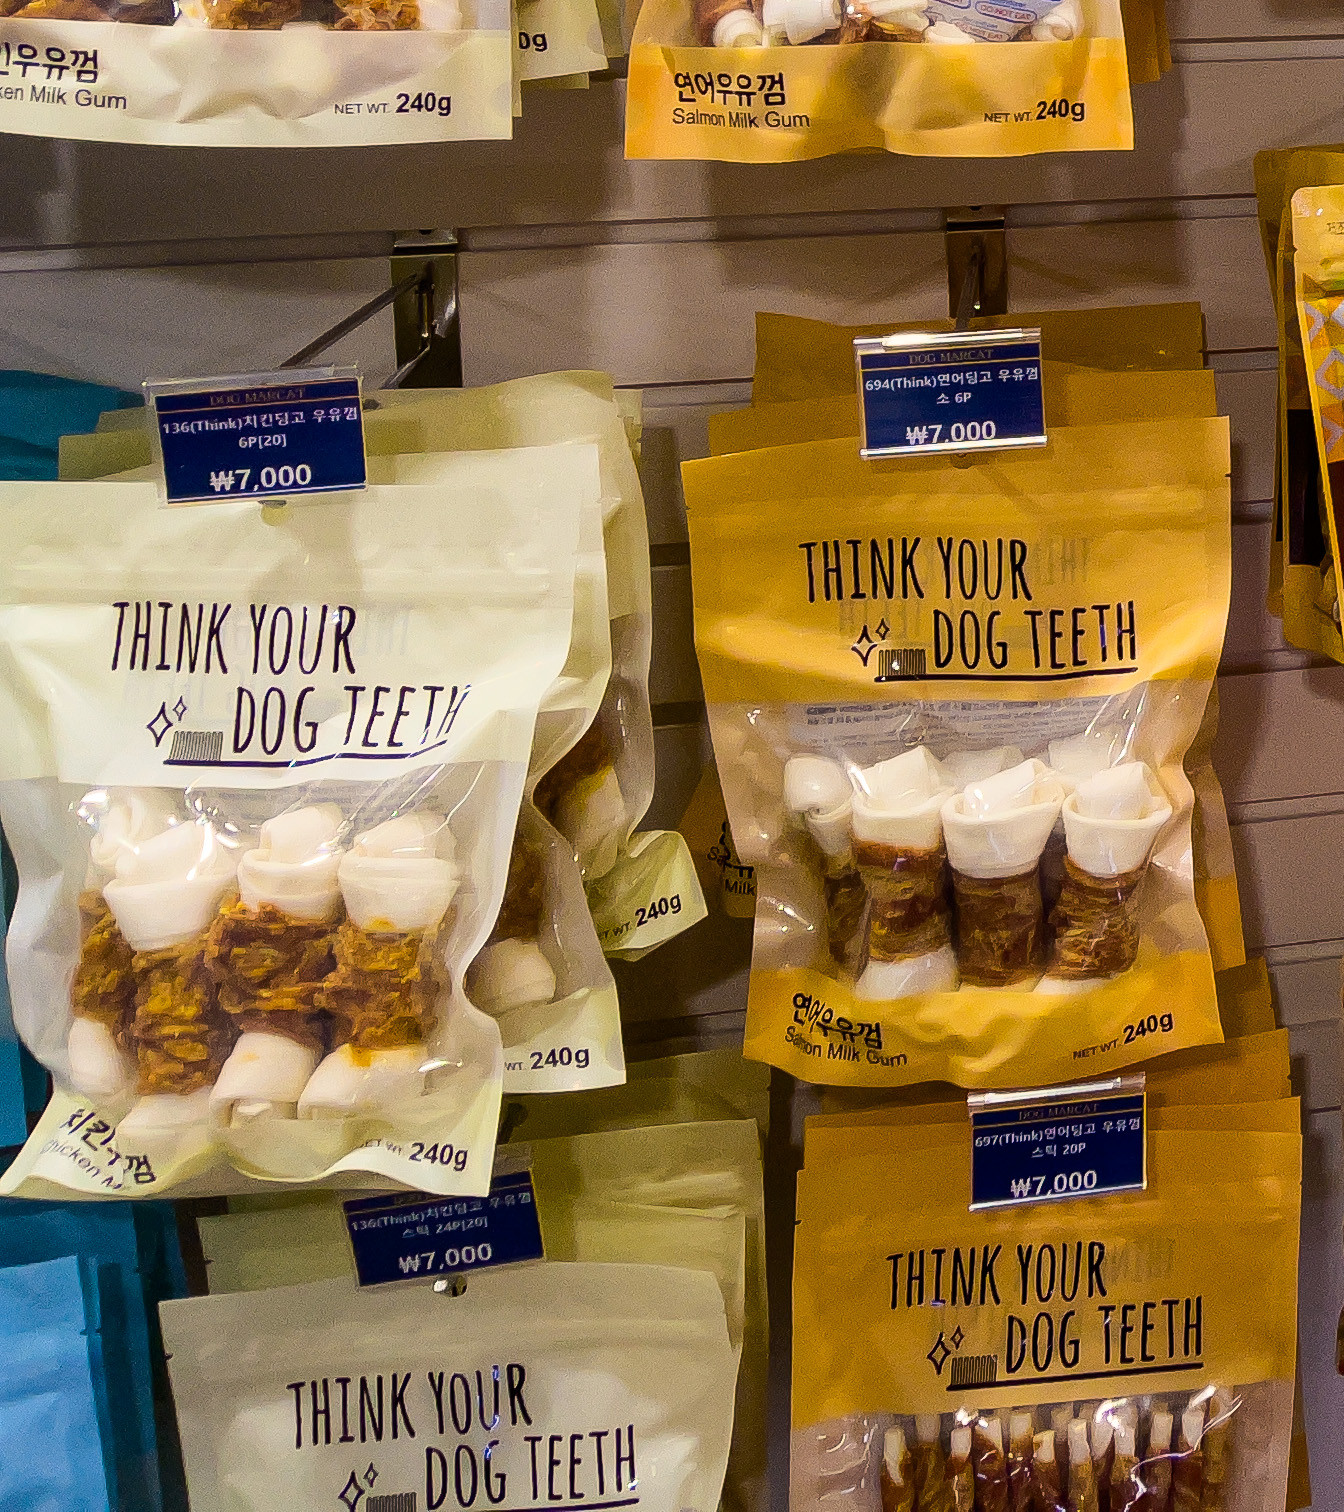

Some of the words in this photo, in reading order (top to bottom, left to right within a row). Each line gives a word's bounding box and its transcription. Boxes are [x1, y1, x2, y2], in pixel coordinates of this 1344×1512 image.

[30, 86, 67, 105] Milk
[74, 84, 127, 110] Gum
[395, 93, 452, 117] 240g
[674, 71, 786, 107] 연어우유껌
[672, 108, 726, 127] Salmon
[728, 109, 759, 128] Milk
[764, 108, 810, 128] Gum
[1036, 98, 1085, 121] 240g
[799, 538, 925, 603] THINK
[936, 537, 1032, 601] YOUR
[111, 602, 231, 674] THINK
[249, 604, 356, 676] YOUR
[933, 611, 1007, 669] DOG
[1024, 601, 1137, 669] TEETH
[232, 686, 319, 756] DOG
[342, 686, 470, 748] TEETH
[636, 893, 682, 927] 240g
[1123, 1012, 1174, 1045] 240g
[530, 1045, 590, 1071] 240g
[409, 1141, 468, 1171] 240g
[886, 1244, 1002, 1309] THINK
[1016, 1241, 1107, 1299] YOUR
[1005, 1312, 1080, 1374] DOG
[1098, 1295, 1201, 1365] TEETH
[288, 1373, 416, 1448] THINK
[428, 1363, 531, 1437] YOUR
[425, 1440, 508, 1510] DOG
[524, 1424, 638, 1501] TEETH
